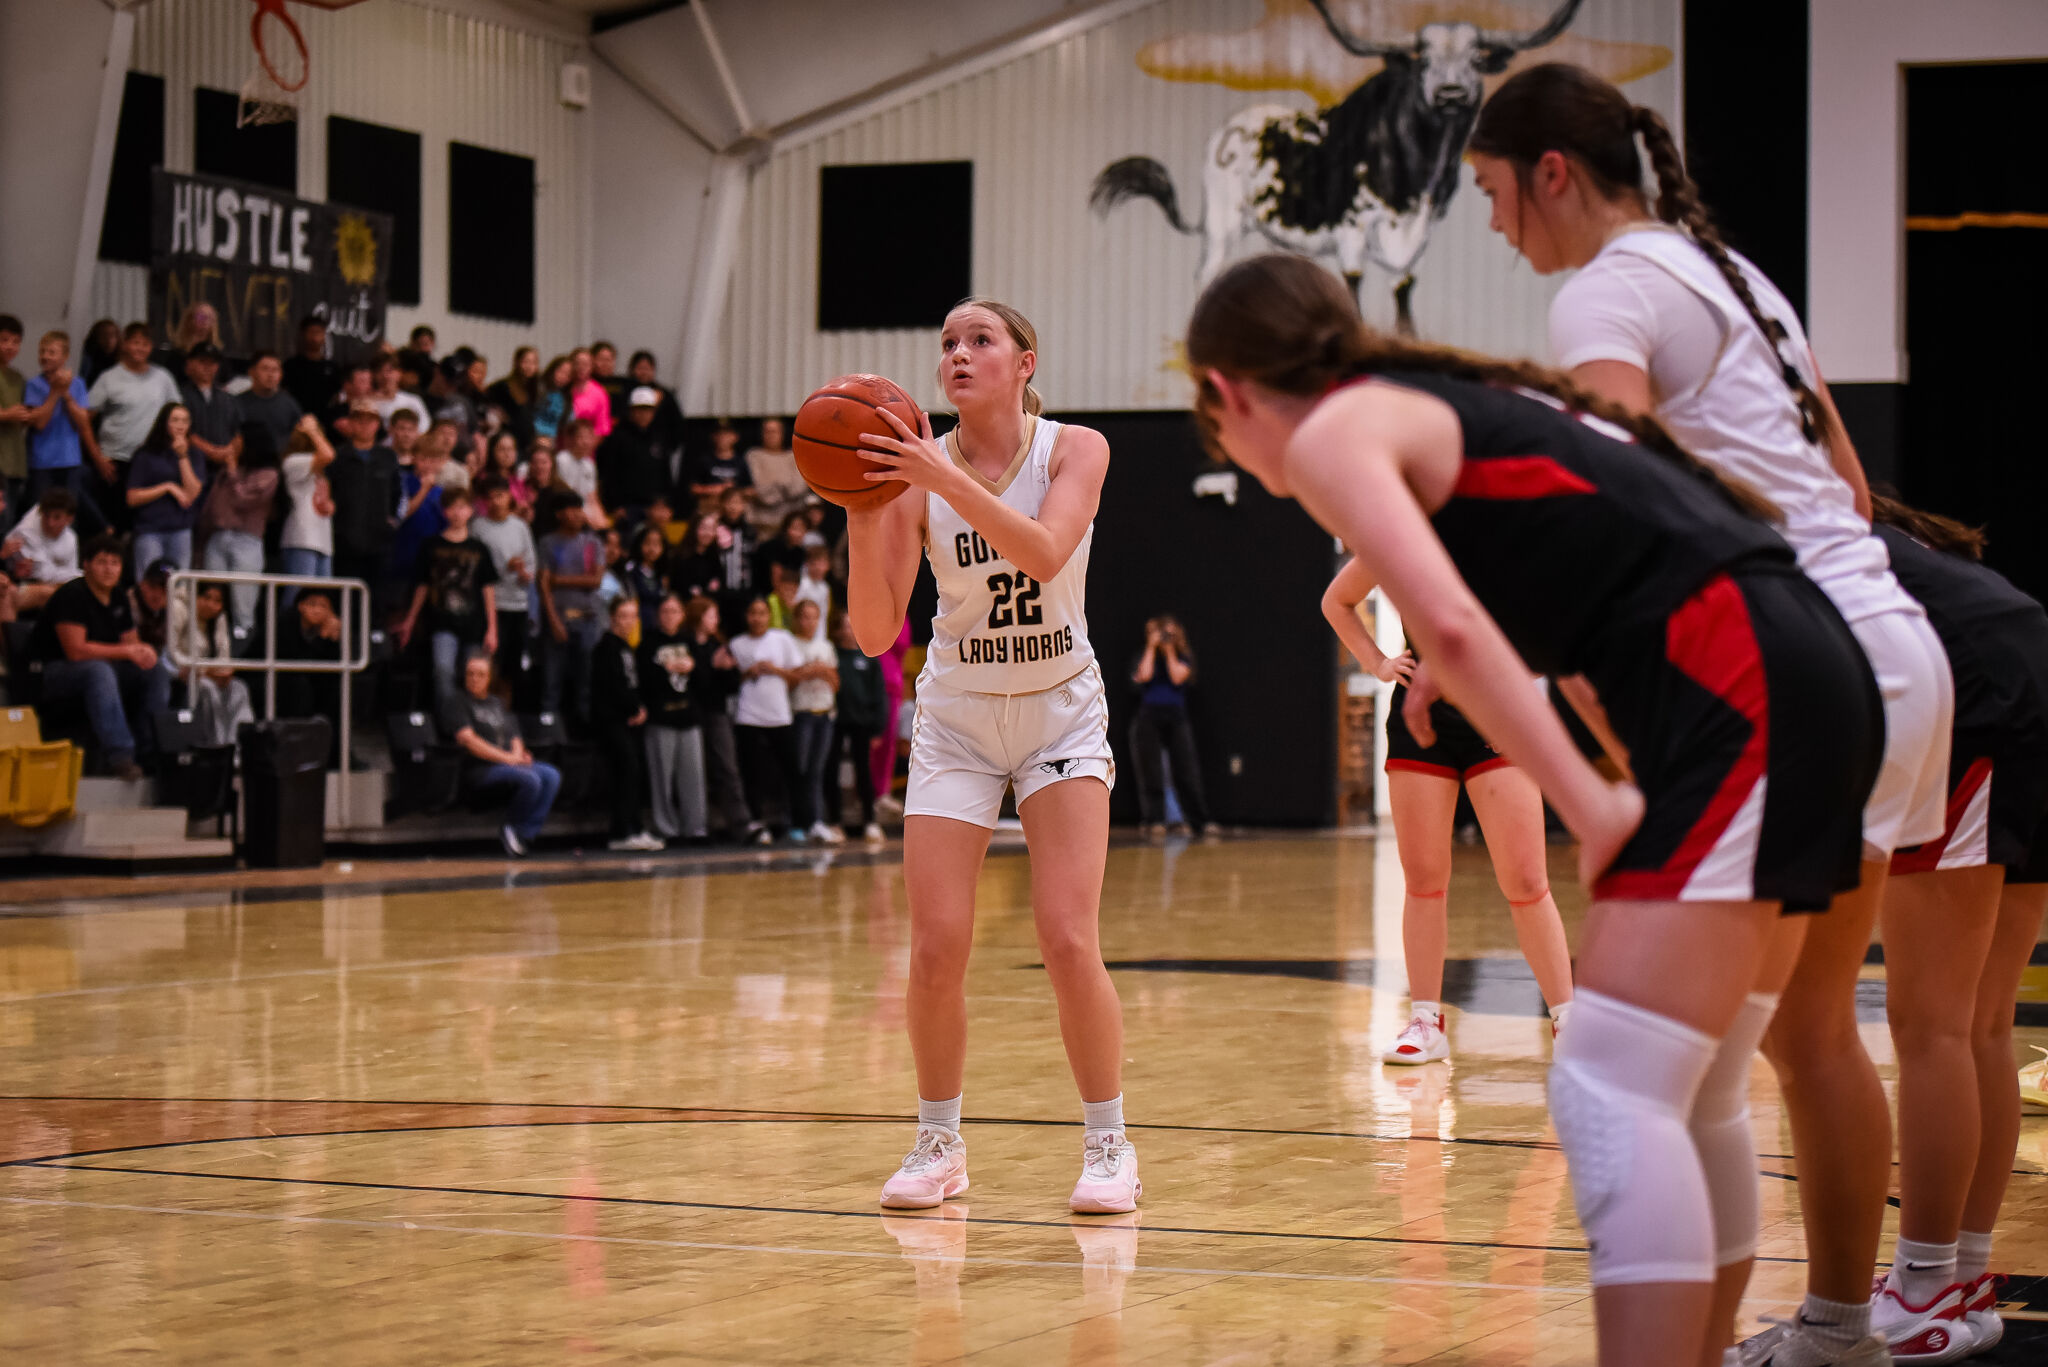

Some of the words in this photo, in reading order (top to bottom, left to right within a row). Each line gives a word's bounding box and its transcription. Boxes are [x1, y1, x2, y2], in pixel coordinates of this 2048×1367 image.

[171, 183, 313, 272] HUSTLE
[986, 570, 1044, 630] 22
[958, 636, 1008, 665] LADY
[1012, 624, 1074, 664] HORNS
